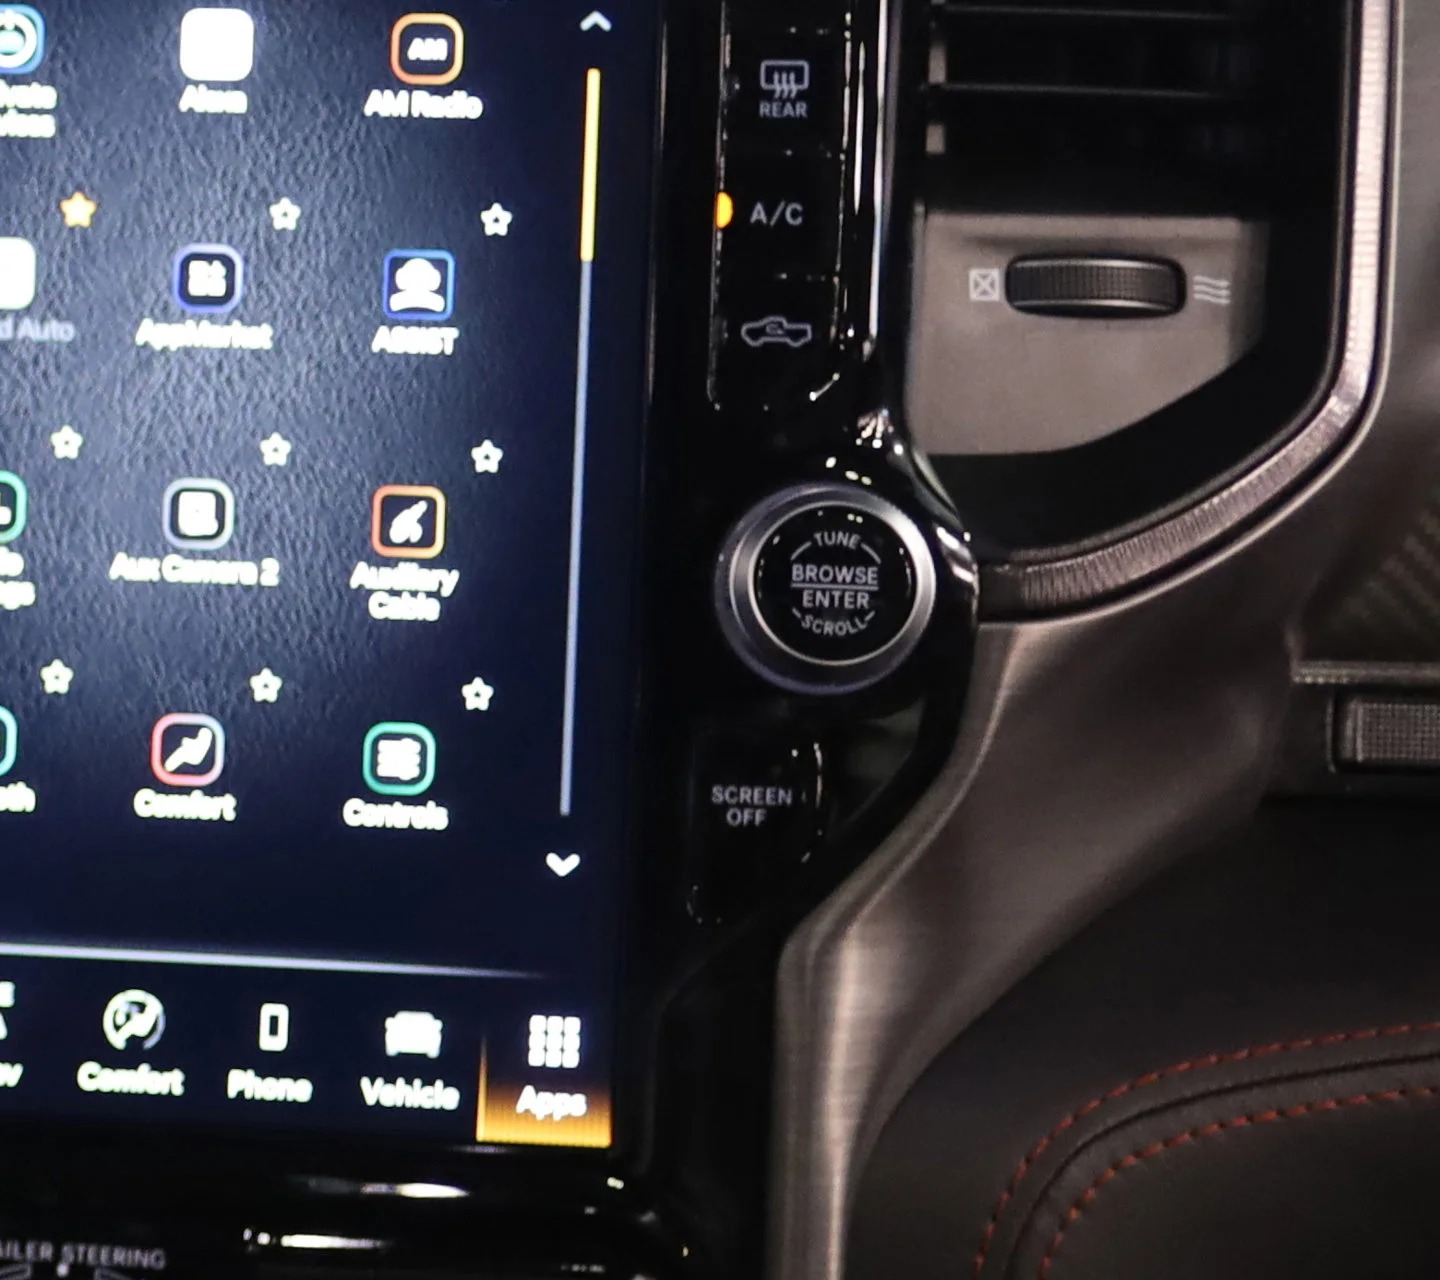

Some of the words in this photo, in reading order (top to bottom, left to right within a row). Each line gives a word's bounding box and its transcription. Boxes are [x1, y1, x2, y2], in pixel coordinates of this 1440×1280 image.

[364, 89, 409, 118] AM
[411, 90, 484, 120] Radio
[759, 101, 808, 118] REAR
[750, 201, 803, 226] A/C
[16, 315, 77, 343] Auto
[813, 530, 862, 551] TUNE
[109, 552, 160, 582] Aux
[260, 558, 280, 587] 2
[791, 563, 879, 584] BROWSE
[802, 589, 870, 610] ENTER
[800, 614, 867, 637] SCROLL
[711, 785, 793, 806] SCREEN
[726, 807, 767, 827] OFF
[76, 1060, 185, 1097] Comfort
[227, 1068, 314, 1103] Phone
[360, 1076, 461, 1111] Vehicle
[515, 1084, 588, 1121] Apps
[60, 1242, 167, 1271] STEERING
